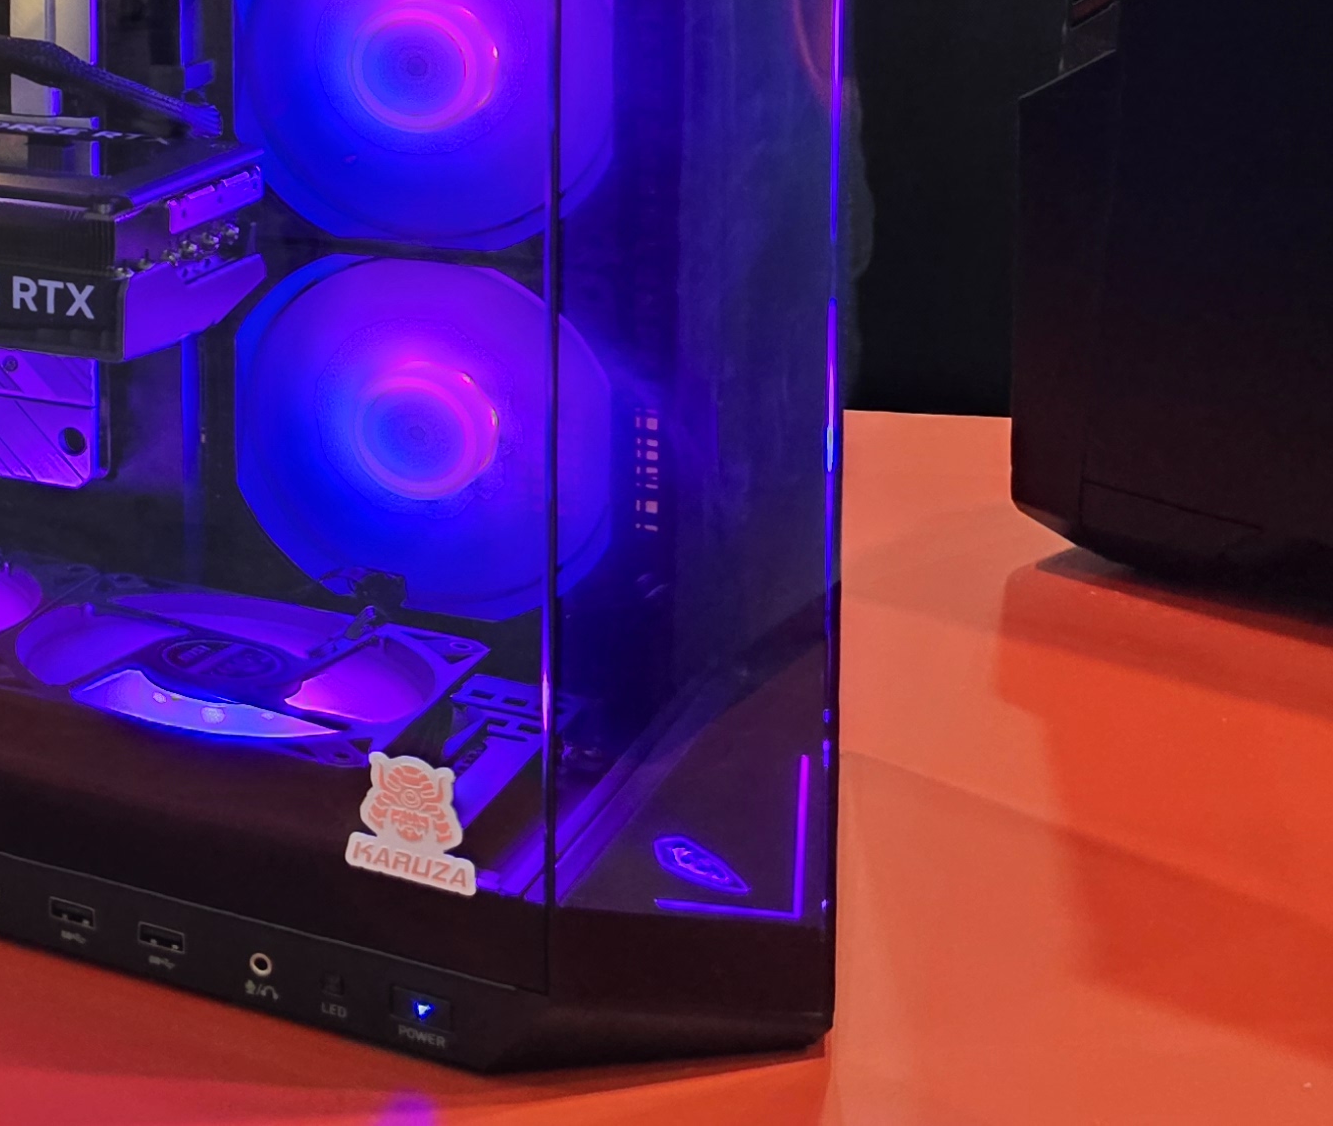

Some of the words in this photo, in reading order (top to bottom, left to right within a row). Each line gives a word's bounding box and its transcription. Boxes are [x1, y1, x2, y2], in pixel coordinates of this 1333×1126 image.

[12, 277, 95, 320] RTX
[352, 840, 469, 888] KARUZA
[321, 1001, 348, 1018] LED
[398, 1024, 446, 1048] POWER
